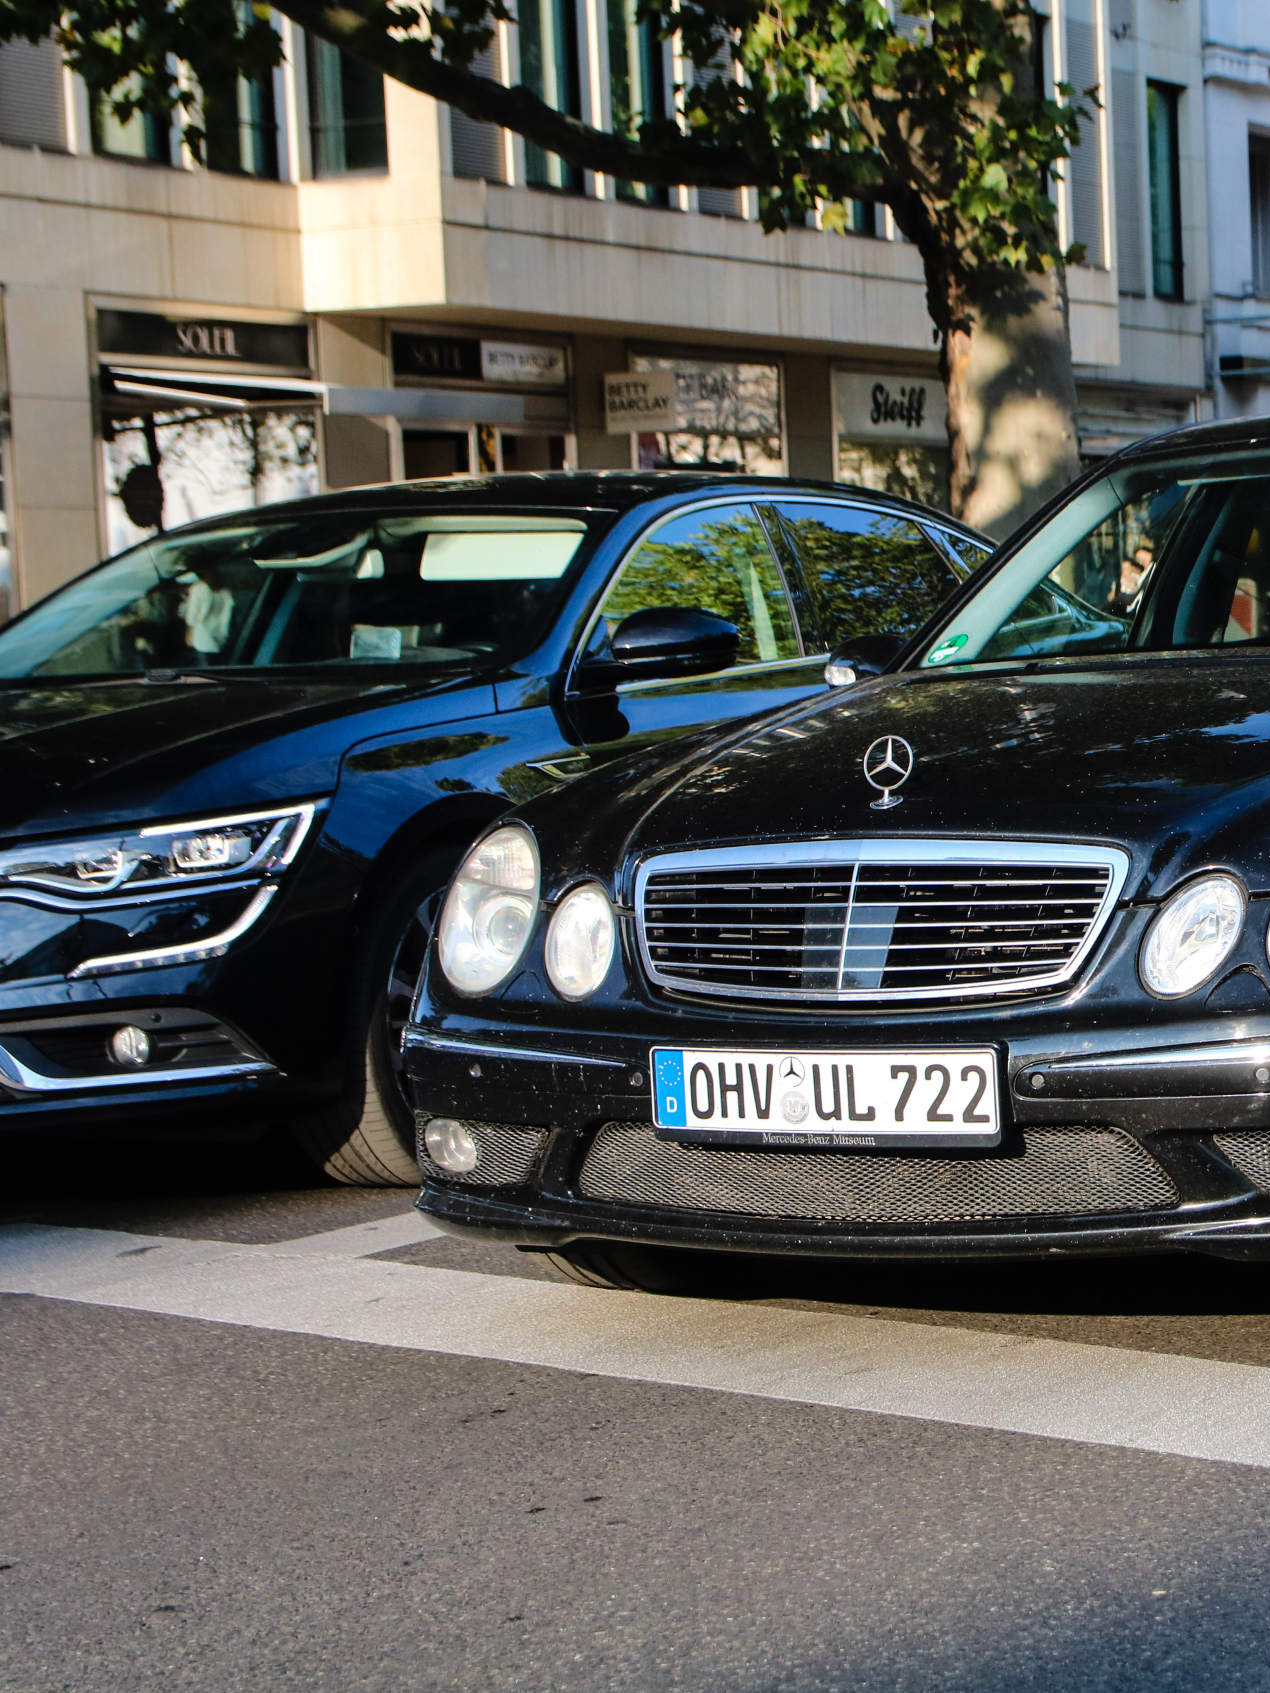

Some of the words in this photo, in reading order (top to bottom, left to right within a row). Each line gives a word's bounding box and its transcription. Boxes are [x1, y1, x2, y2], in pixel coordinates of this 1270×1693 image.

[608, 381, 649, 398] BETTY
[608, 396, 670, 414] BARCLAY
[870, 382, 926, 429] Steiff
[690, 1062, 774, 1120] OHV
[812, 1063, 876, 1122] UL
[890, 1064, 991, 1124] 722
[666, 1096, 678, 1113] D
[762, 1132, 830, 1145] Mercedes-Benz
[833, 1135, 876, 1146] Museum
